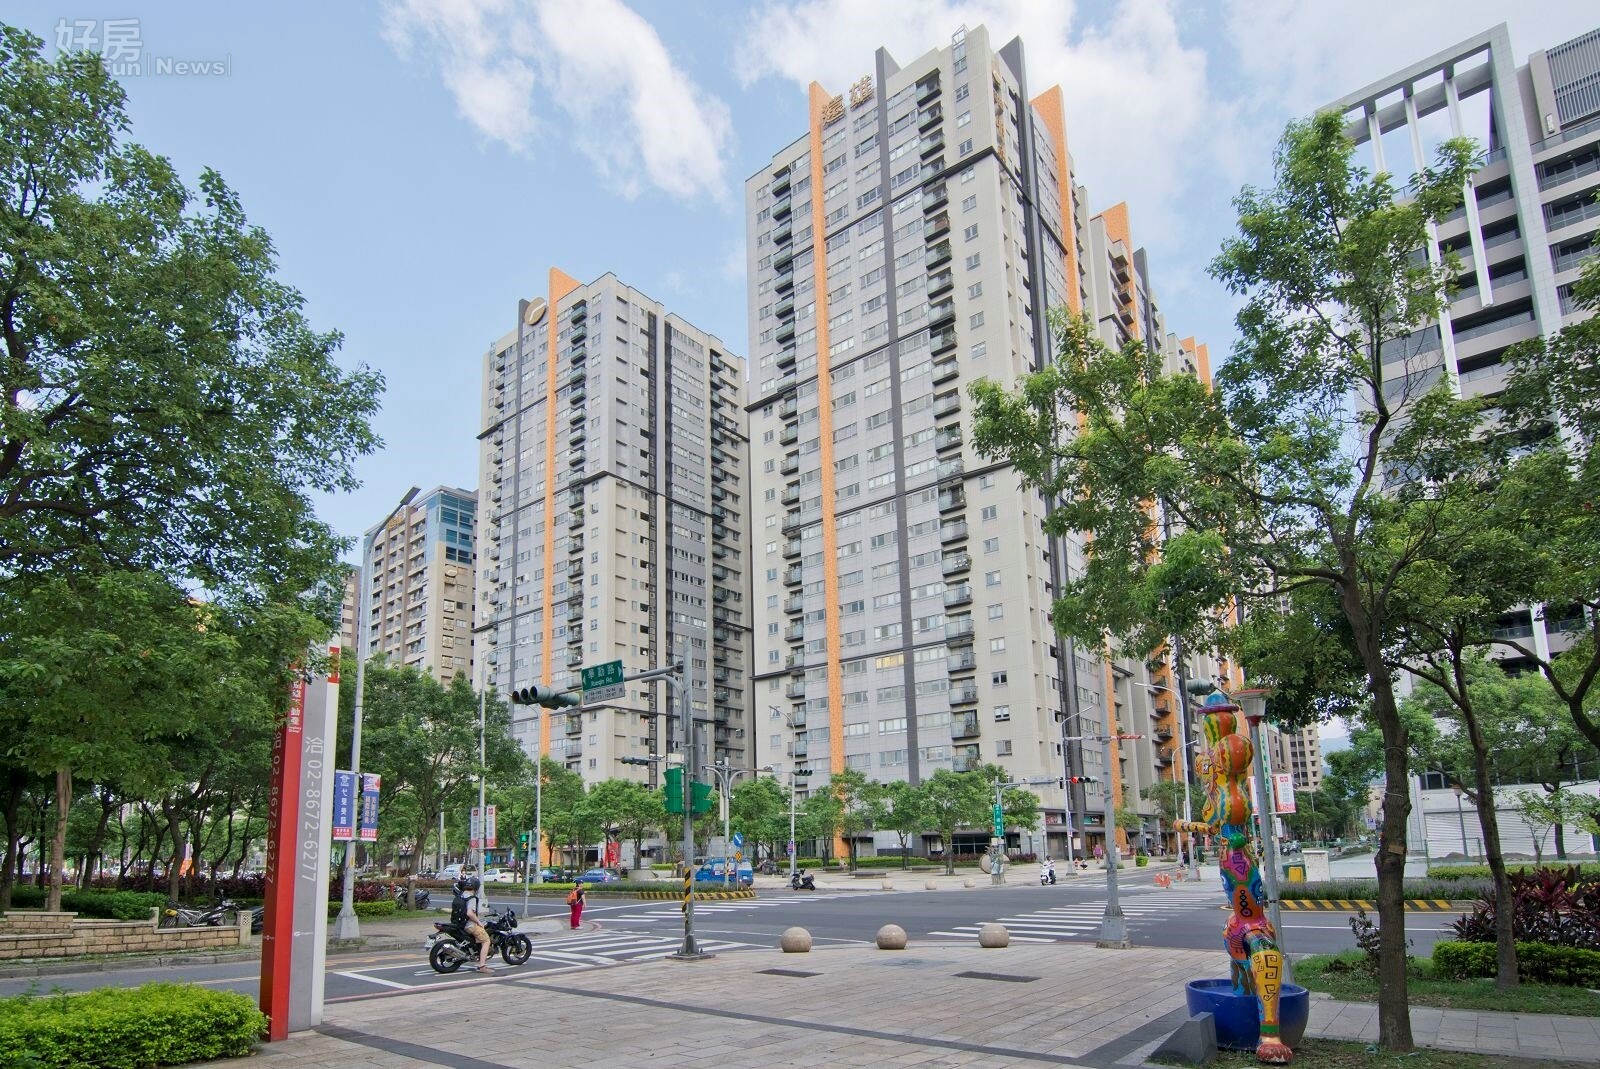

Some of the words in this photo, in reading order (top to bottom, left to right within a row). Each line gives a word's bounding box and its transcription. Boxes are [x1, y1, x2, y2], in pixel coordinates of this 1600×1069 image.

[305, 736, 324, 754] 洽
[266, 755, 281, 884] 02-8672-6277
[301, 760, 322, 882] 02-8672-6277
